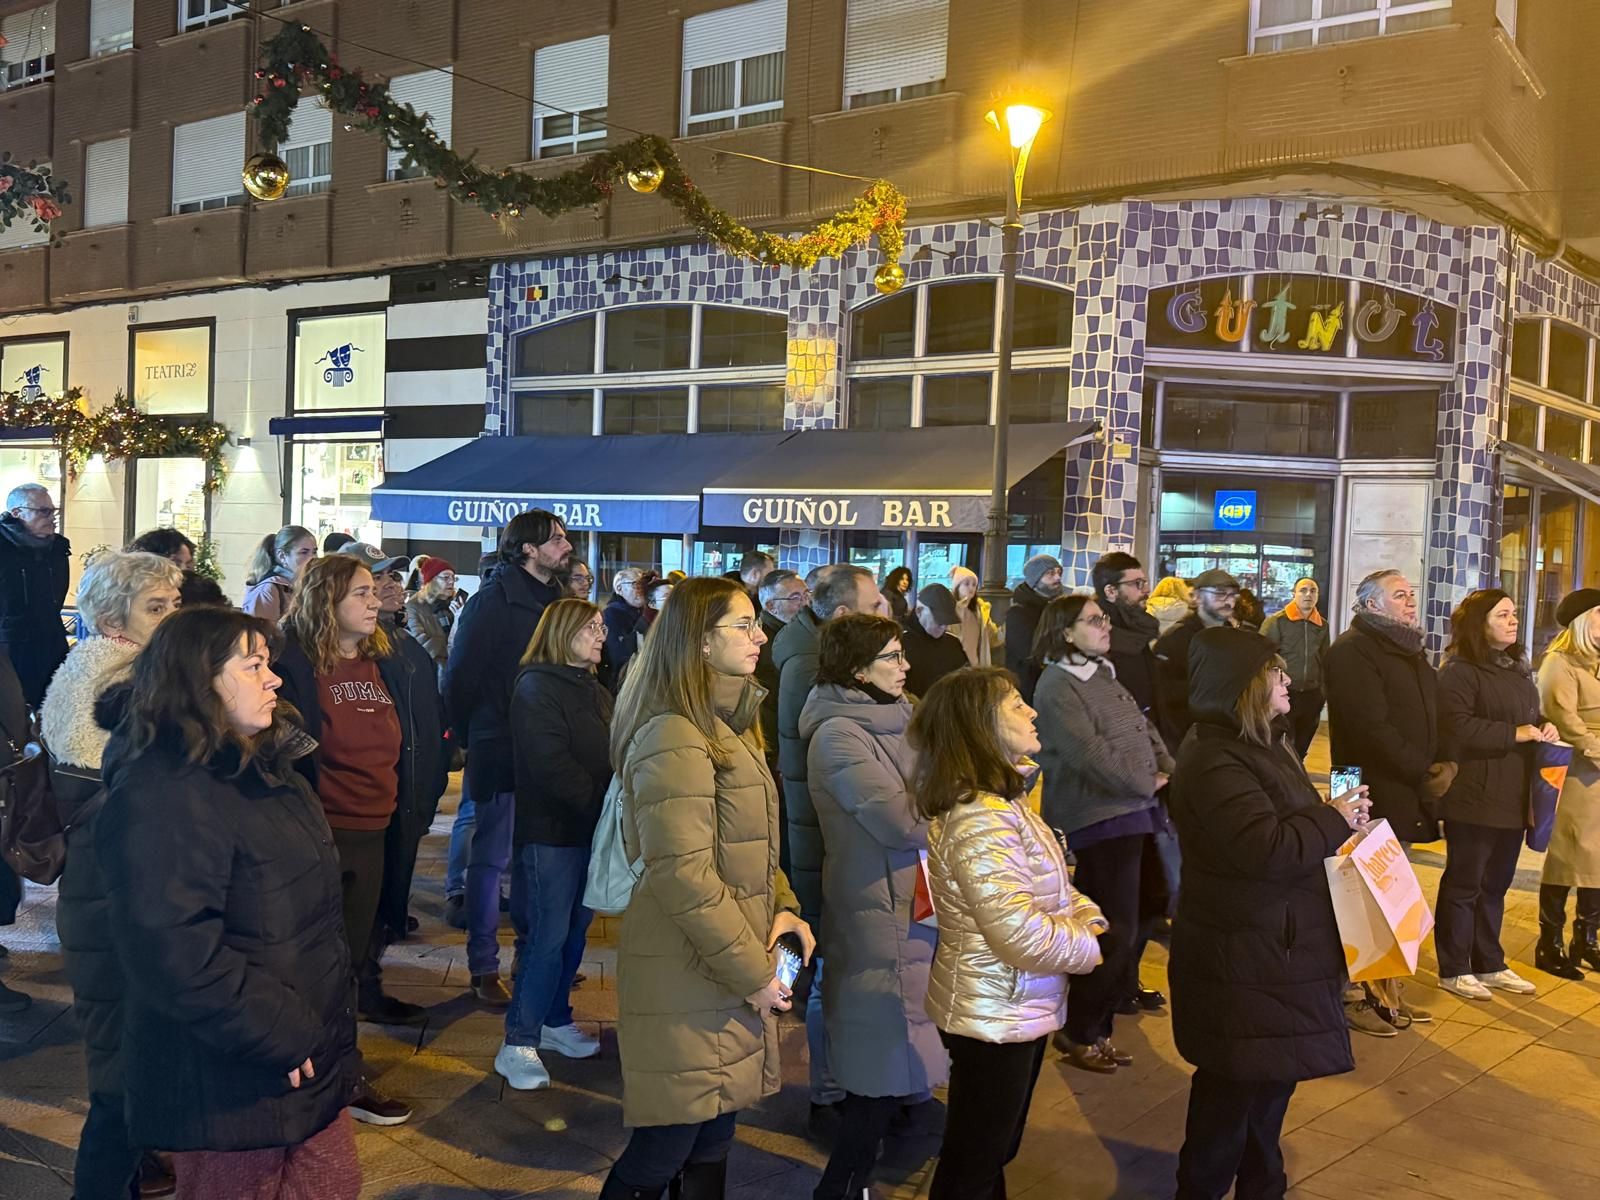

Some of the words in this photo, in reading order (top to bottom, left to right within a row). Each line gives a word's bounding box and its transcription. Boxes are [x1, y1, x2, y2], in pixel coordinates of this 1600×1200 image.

[145, 362, 197, 380] TEATRIZ
[553, 503, 603, 527] BAR
[742, 497, 858, 526] GUIÑOL
[881, 500, 953, 528] BAR
[329, 681, 392, 705] PUMA
